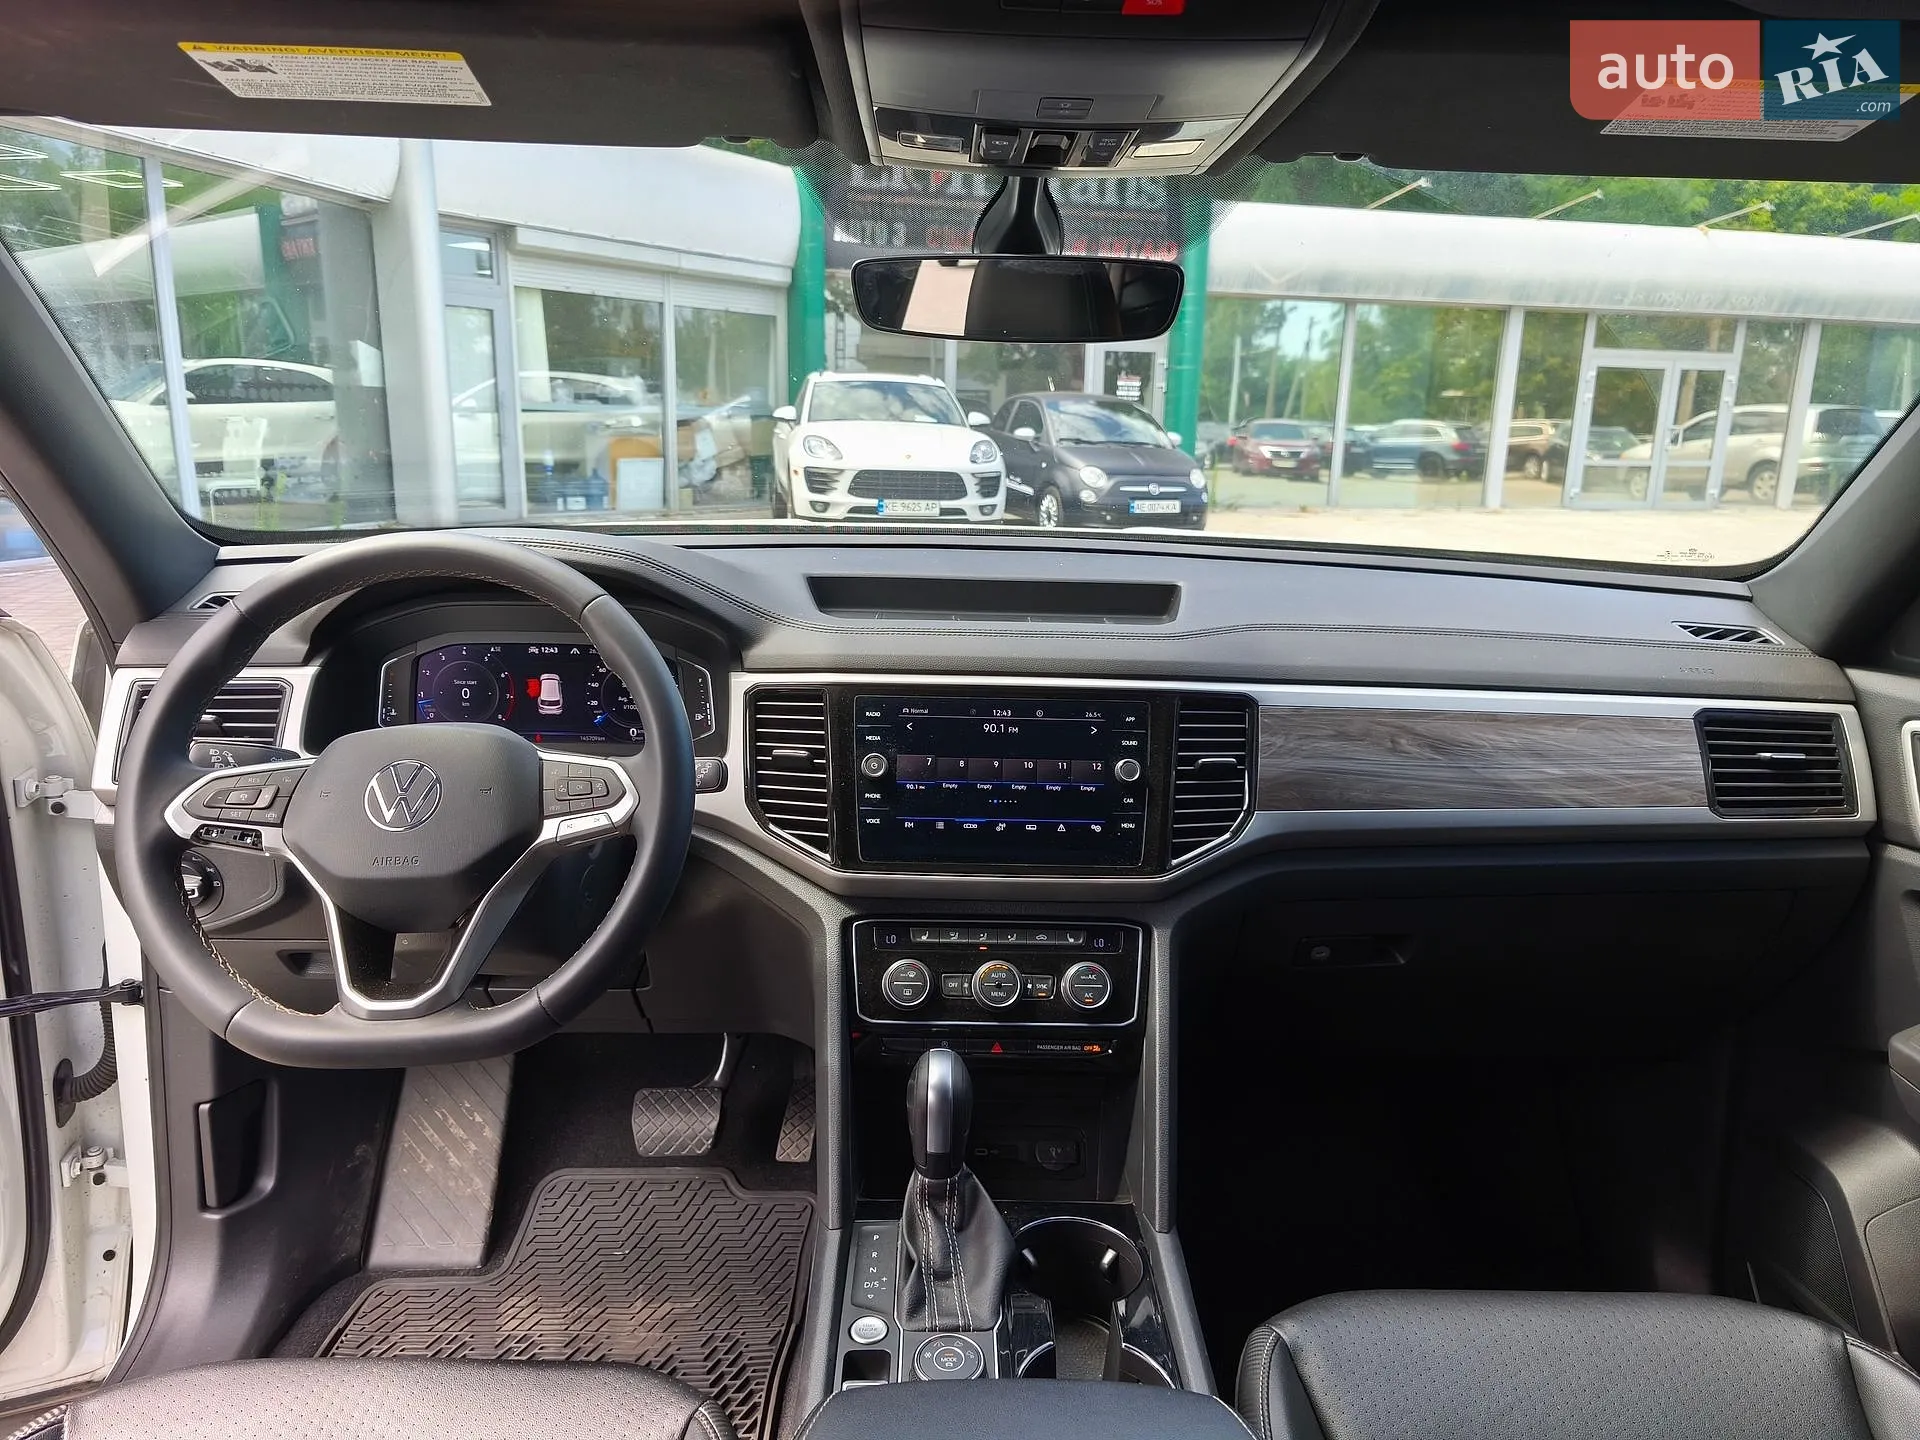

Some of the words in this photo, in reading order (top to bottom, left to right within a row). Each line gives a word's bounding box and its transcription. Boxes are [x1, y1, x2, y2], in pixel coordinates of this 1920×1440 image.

[461, 687, 470, 699] 0
[992, 709, 1012, 717] 12:43
[983, 723, 1005, 733] 90.1
[1008, 726, 1019, 734] FM
[926, 757, 932, 766] 7
[993, 760, 999, 768] 9
[1023, 761, 1034, 769] 10
[1058, 762, 1067, 770] 11
[1092, 763, 1102, 771] 12
[372, 855, 420, 867] AIRBAG
[1036, 982, 1049, 990] SYNC
